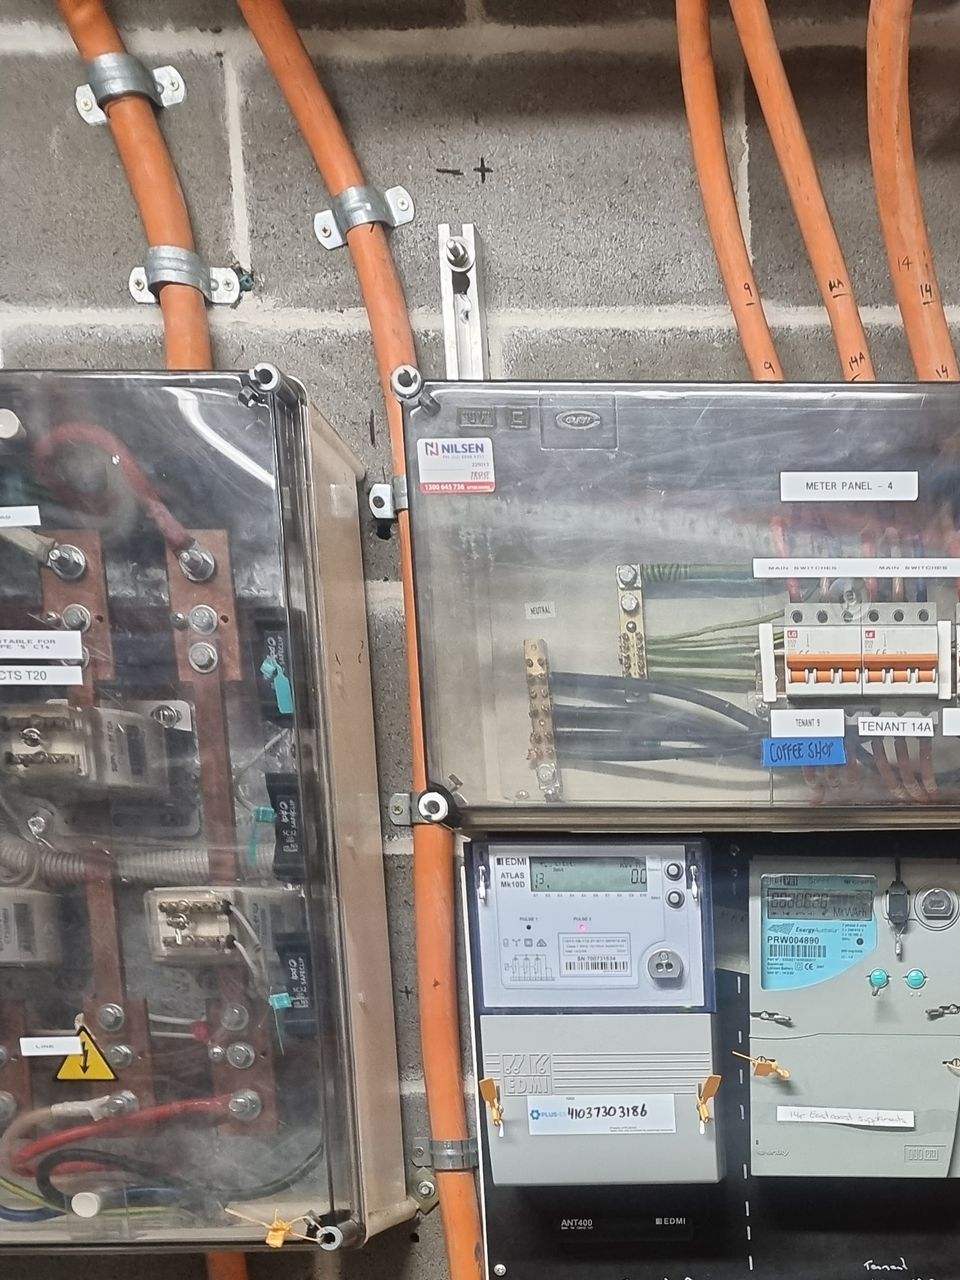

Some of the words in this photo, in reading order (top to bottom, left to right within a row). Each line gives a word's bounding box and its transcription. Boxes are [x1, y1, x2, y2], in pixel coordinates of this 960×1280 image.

[897, 256, 912, 272] 14
[743, 282, 752, 297] 9
[920, 284, 933, 298] 14
[763, 361, 775, 374] 9
[936, 364, 948, 379] 14
[441, 443, 485, 454] NILSEN
[806, 482, 837, 490] METER
[842, 482, 872, 490] PANEL
[888, 481, 893, 490] 4
[0, 670, 22, 681] CTS
[25, 670, 47, 681] T20
[795, 719, 815, 727] TENANT
[860, 721, 907, 732] TENANT
[912, 722, 931, 732] 14A
[769, 742, 803, 763] COFFEE
[808, 741, 835, 759] SHOP
[505, 857, 527, 866] EDMI
[500, 872, 525, 880] ATLAS
[500, 880, 526, 888] Mk10D
[767, 936, 820, 945] PRW004890
[567, 1104, 648, 1120] 41037303186
[561, 1219, 593, 1227] ANT400
[663, 1217, 686, 1225] EDMI
